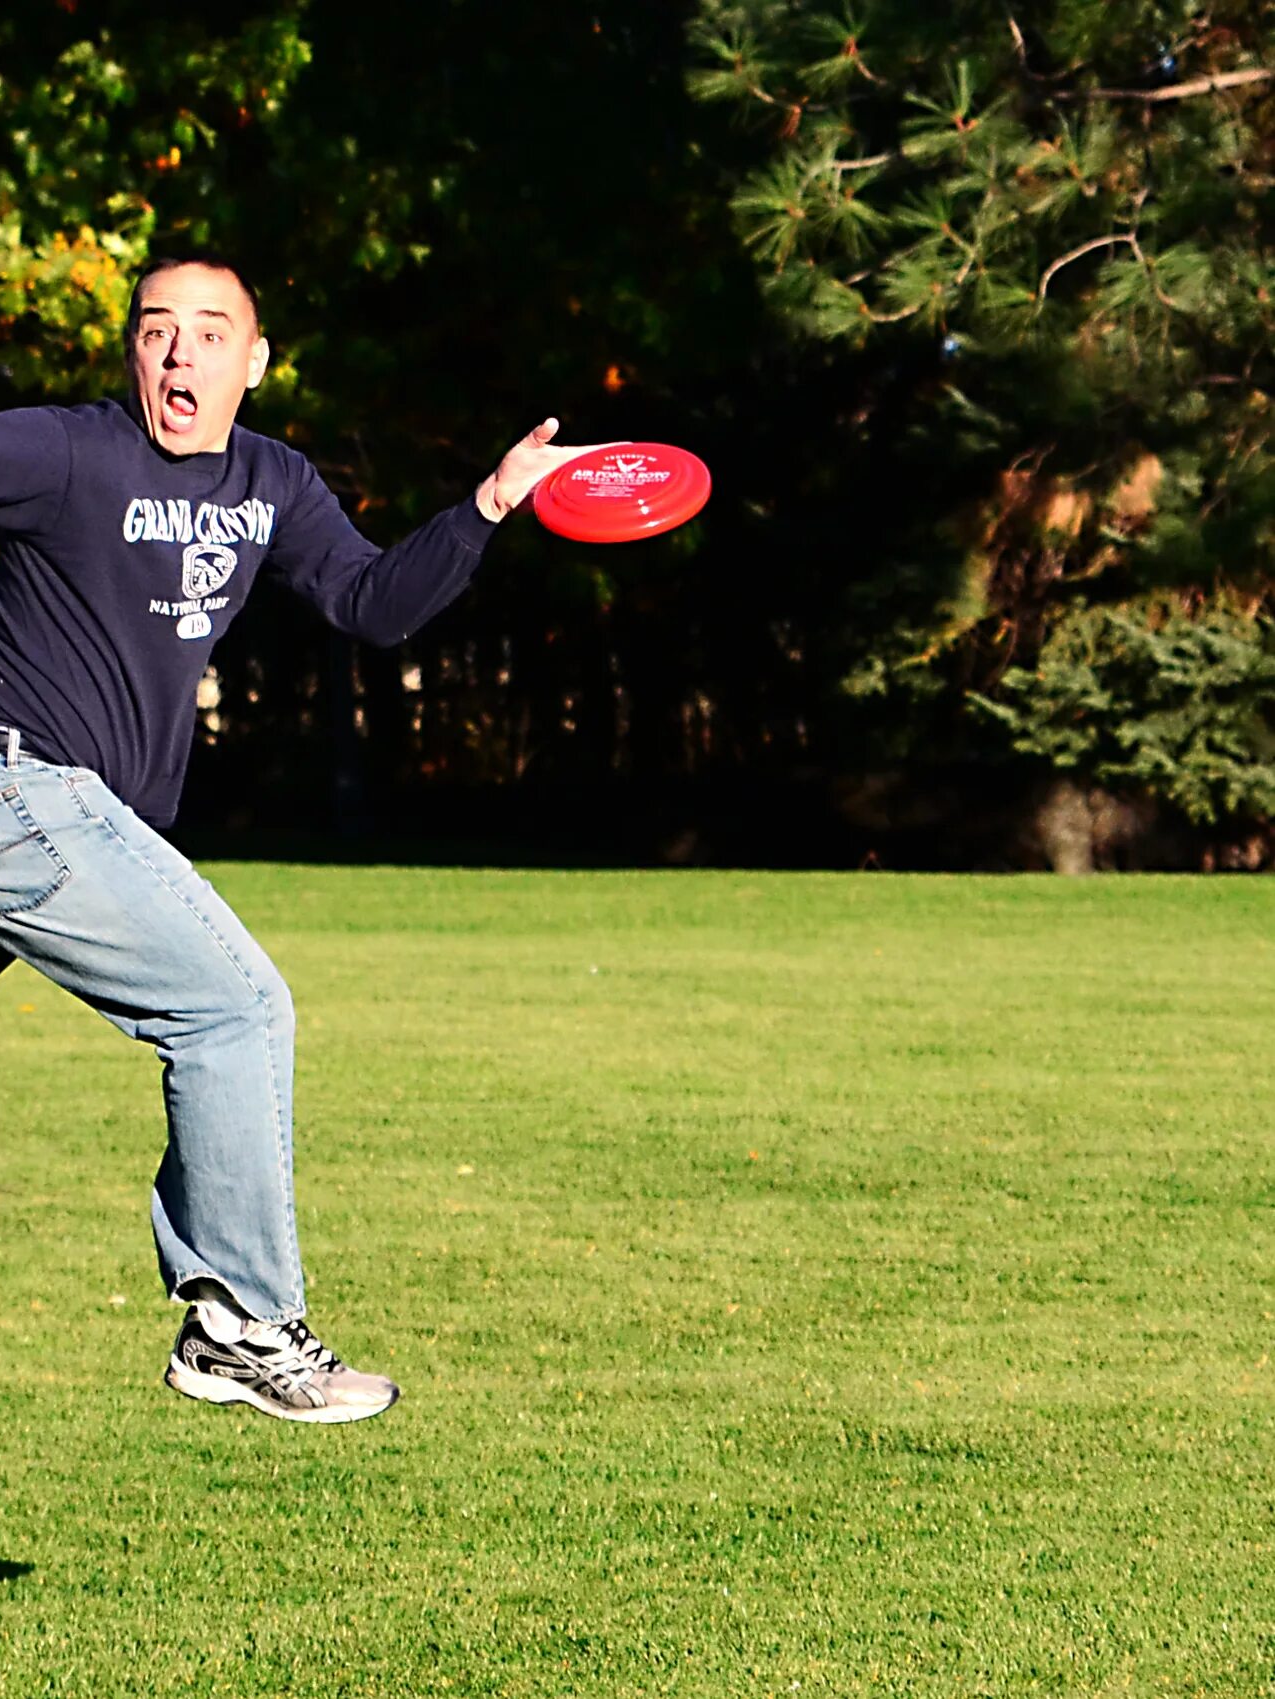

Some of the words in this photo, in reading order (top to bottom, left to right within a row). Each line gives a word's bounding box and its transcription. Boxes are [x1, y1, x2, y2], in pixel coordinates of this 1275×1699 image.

[572, 469, 594, 478] AIR
[595, 471, 636, 479] FORCE
[637, 471, 671, 479] ROTC
[123, 498, 193, 544] GRAND
